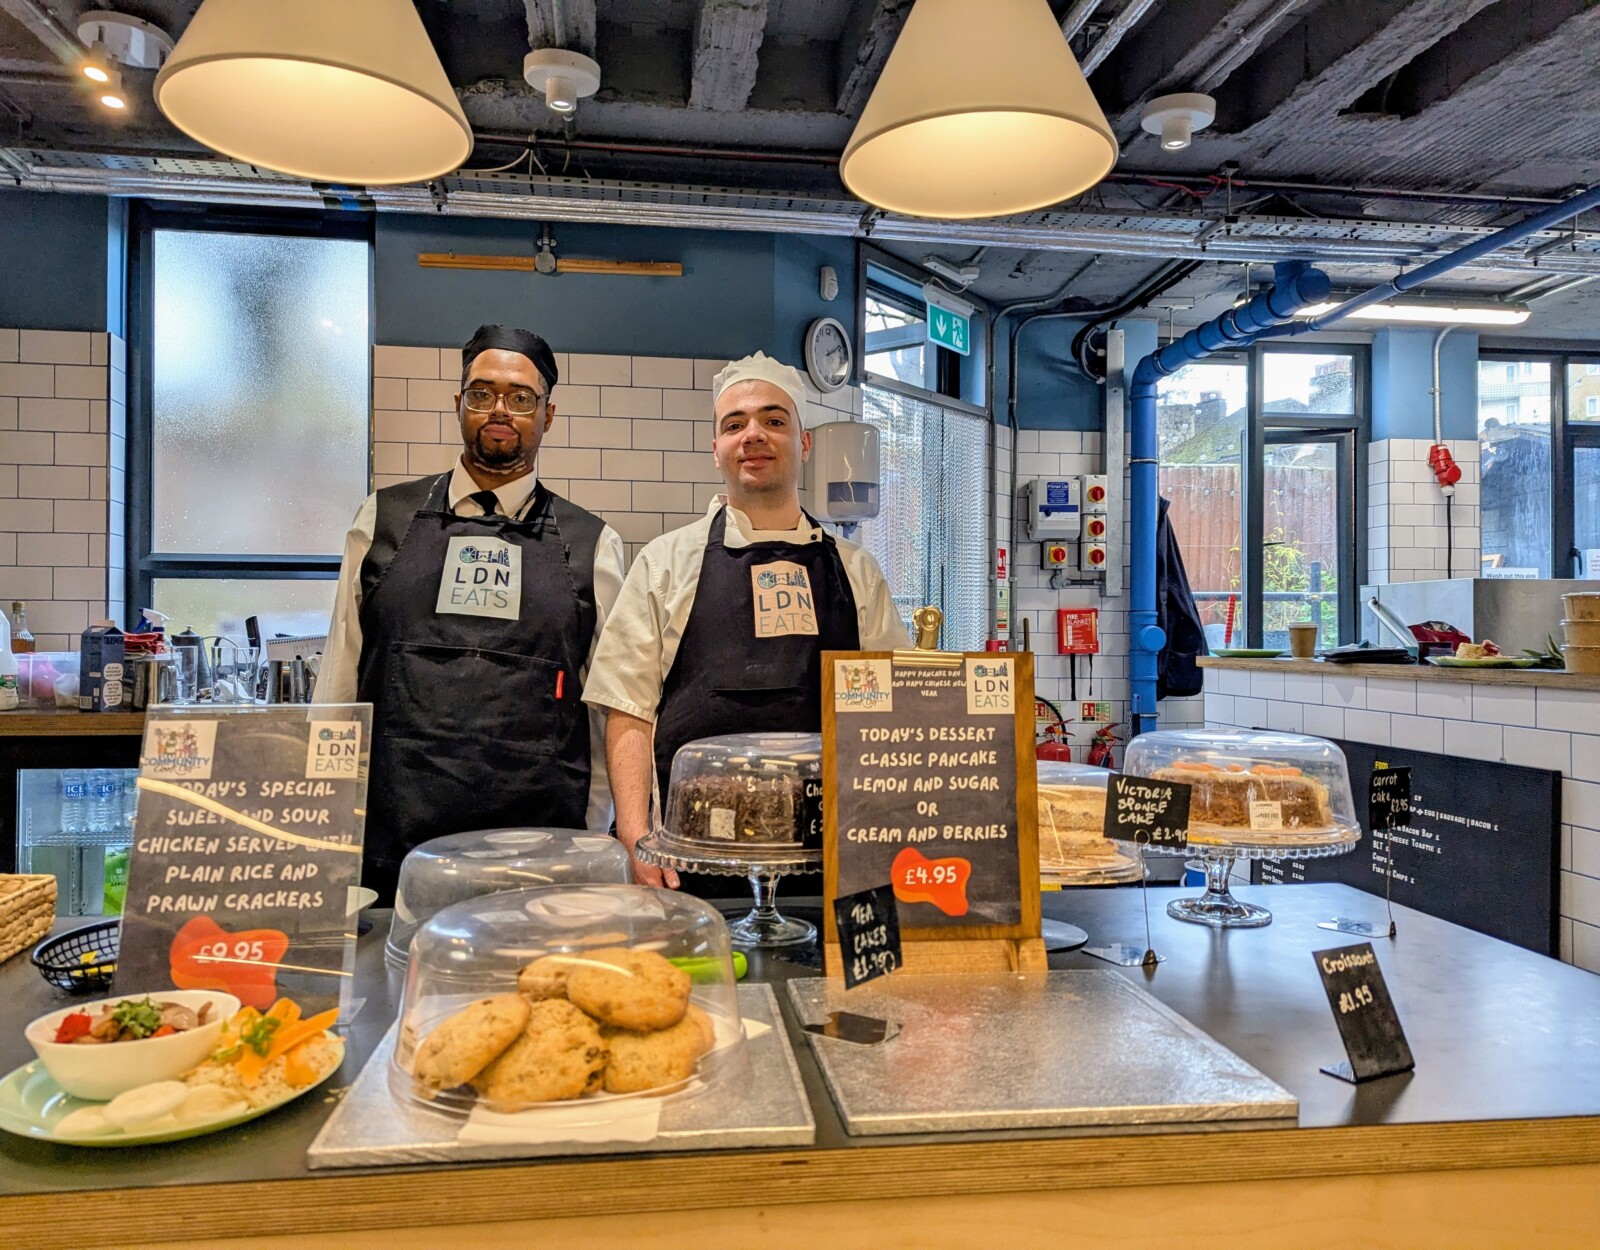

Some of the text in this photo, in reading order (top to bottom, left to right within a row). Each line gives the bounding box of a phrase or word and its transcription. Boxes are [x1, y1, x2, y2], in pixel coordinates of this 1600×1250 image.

[455, 567, 509, 587] LDN
[451, 587, 508, 608] EATS
[759, 591, 811, 612] LDN
[760, 613, 814, 634] EATS
[975, 680, 1008, 692] LDN
[835, 692, 889, 700] COMMUNITY
[975, 695, 1010, 707] EATS
[860, 727, 996, 742] TODAY'S DESSERT
[317, 743, 356, 756] LDN
[860, 750, 997, 767] CLASSIC PANCAKE
[314, 758, 354, 772] EATS
[260, 781, 336, 798] SPECIAL
[853, 776, 1000, 793] LEMON AND SUGAR
[1117, 778, 1172, 800] VICTORIA
[917, 801, 939, 817] OR
[1118, 798, 1167, 814] SPONGE
[280, 808, 330, 825] SOUR
[1118, 812, 1154, 825] CAKE
[1424, 809, 1436, 817] EGG
[1440, 813, 1465, 824] SAUSAGE
[1471, 820, 1491, 830] BACON
[847, 824, 1008, 843] CREAM AND BERRIES
[137, 836, 219, 855] CHICKEN
[165, 863, 318, 883] PLAIN RICE AND
[905, 866, 957, 885] £4.95
[147, 891, 323, 913] PRAWN CRACKERS
[851, 903, 874, 924] TEA
[854, 925, 887, 954] CAKES
[198, 941, 263, 964] £995
[1322, 950, 1374, 974] Croissant
[1339, 985, 1373, 1014] £1.95
